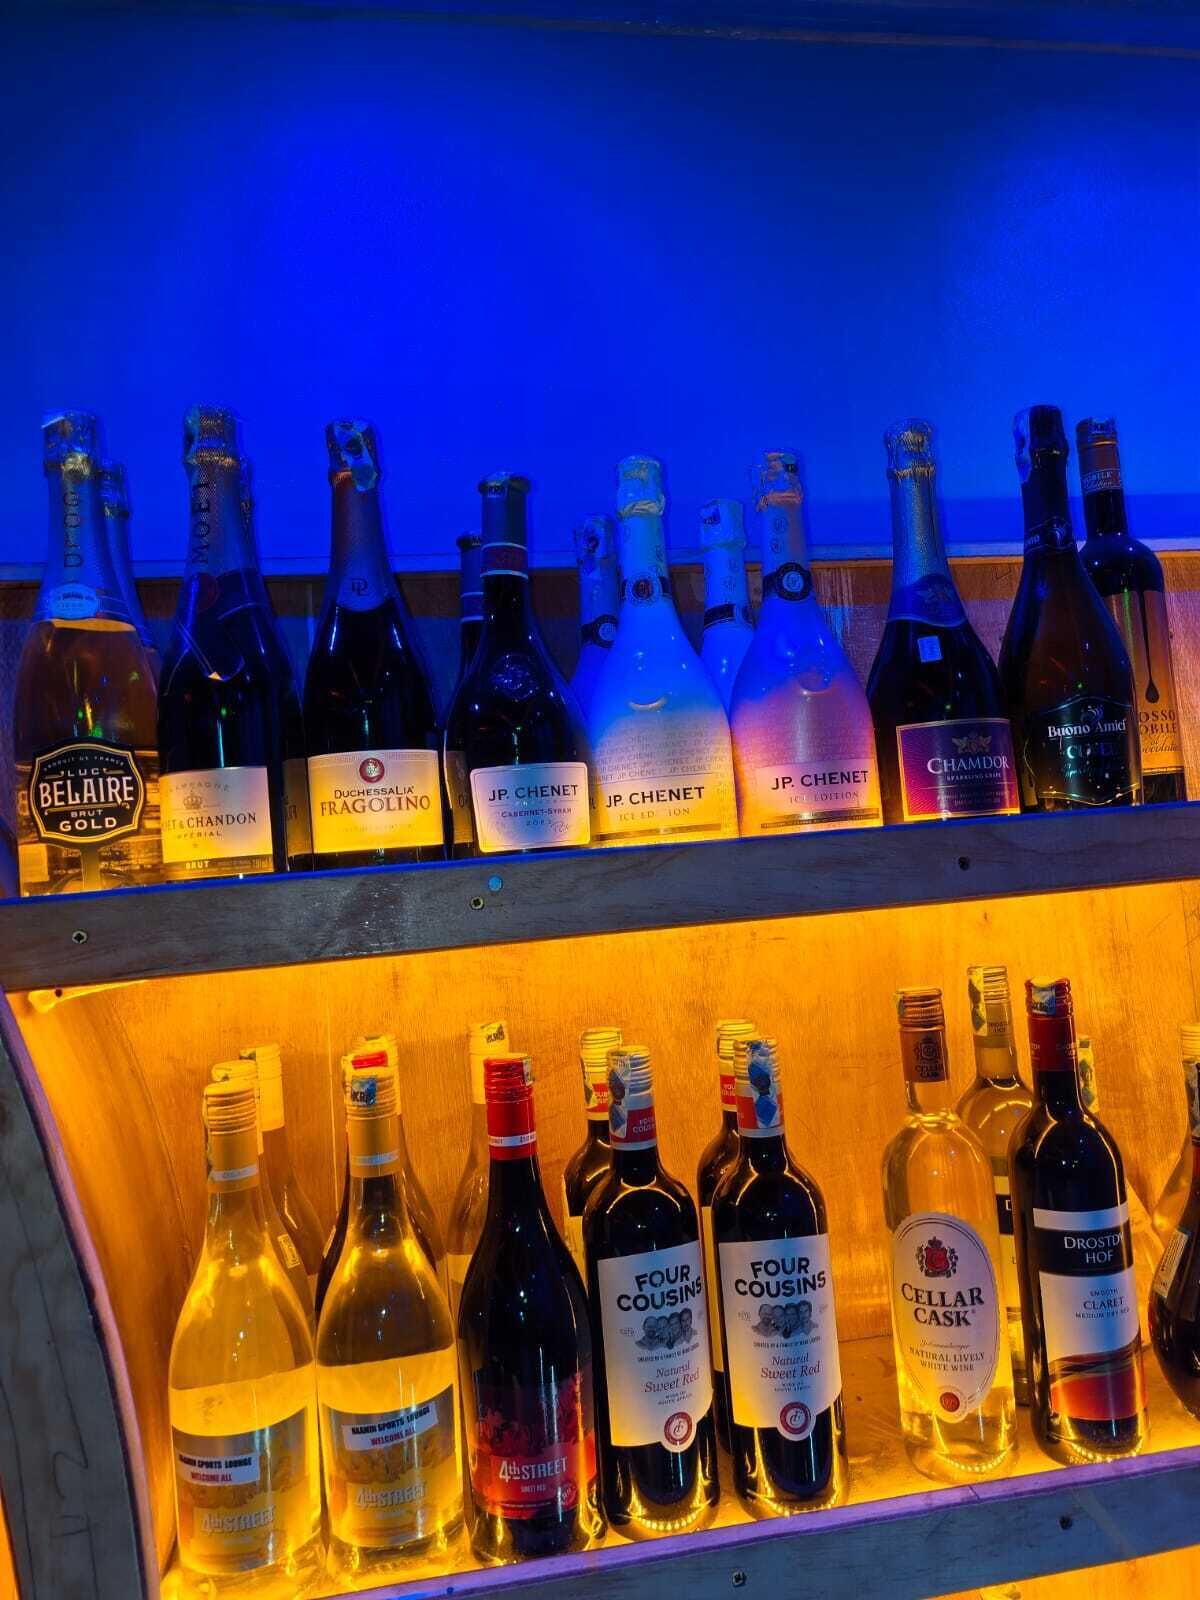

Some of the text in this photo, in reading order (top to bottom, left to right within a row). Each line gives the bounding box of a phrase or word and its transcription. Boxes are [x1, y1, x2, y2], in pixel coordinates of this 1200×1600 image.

[1140, 710, 1176, 722] OSSO
[1047, 719, 1127, 738] Buono Amici
[1140, 722, 1177, 735] OBILE
[67, 767, 100, 777] LUC
[927, 755, 1009, 775] CHAMDOR
[771, 770, 869, 791] JP. CHENET
[39, 776, 134, 808] BELAIRE
[488, 788, 509, 802] JP.
[514, 784, 578, 799] CHENET
[606, 786, 705, 808] JP. CHENET
[71, 809, 104, 818] BRUT
[320, 794, 431, 817] FRAGOLINO
[641, 808, 691, 819] EDION
[60, 817, 117, 832] GOLD
[187, 811, 257, 829] CHANDON
[1085, 1249, 1115, 1264] HOF
[750, 1257, 810, 1279] FOUR
[635, 1264, 691, 1292] FOUR
[735, 1270, 826, 1298] COUSINS
[617, 1275, 702, 1312] COUSINS
[901, 1282, 985, 1307] CELLAR
[1083, 1296, 1125, 1310] CLARET
[914, 1307, 971, 1327] CASK
[772, 1352, 809, 1366] Natural
[910, 1346, 985, 1362] NATURAL LIVELY
[656, 1360, 690, 1378] Natural
[761, 1360, 820, 1379] Sweet Red
[920, 1360, 975, 1372] WHITE WINE
[644, 1367, 700, 1393] Sweet Red
[378, 1417, 405, 1433] SPORTS
[197, 1460, 222, 1469] SPORTS
[224, 1456, 252, 1469] LOUNGE
